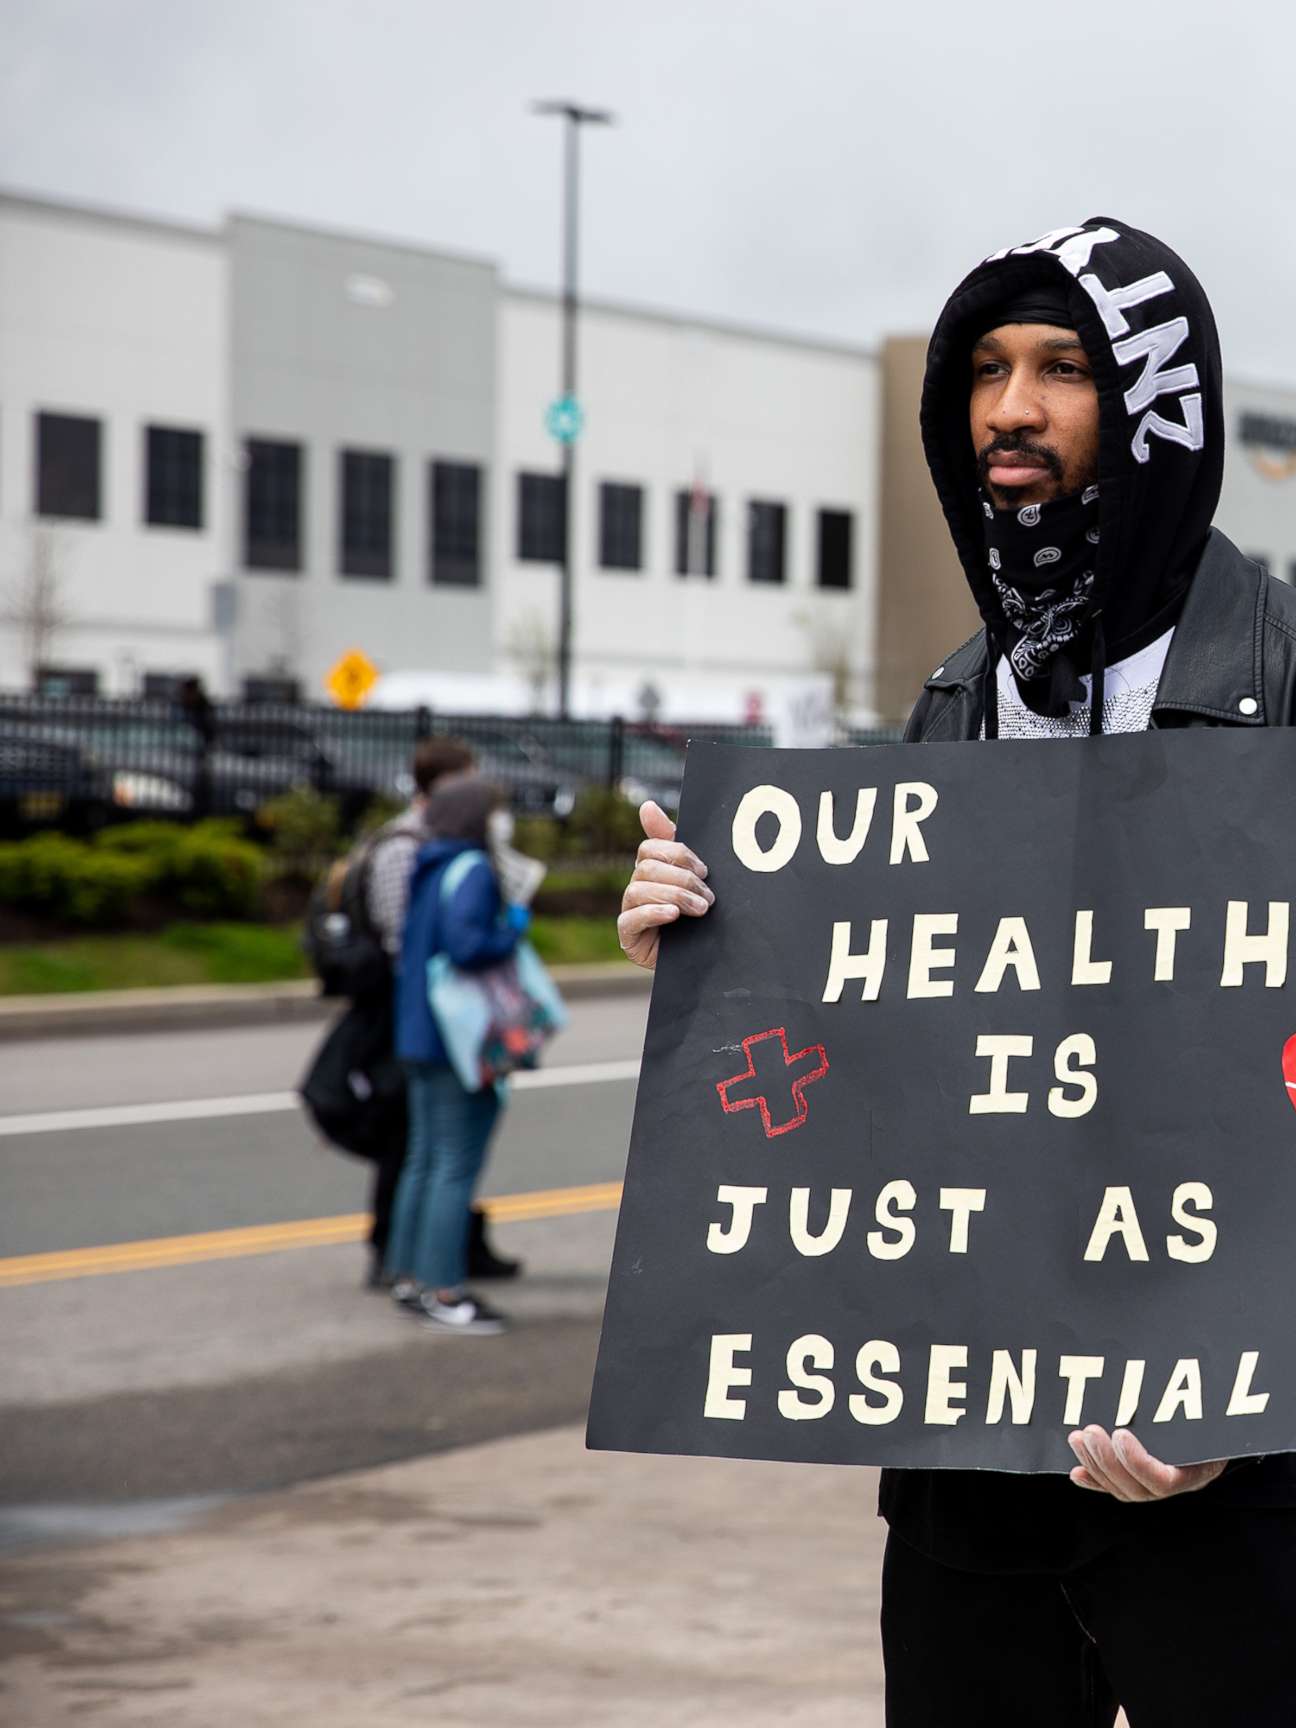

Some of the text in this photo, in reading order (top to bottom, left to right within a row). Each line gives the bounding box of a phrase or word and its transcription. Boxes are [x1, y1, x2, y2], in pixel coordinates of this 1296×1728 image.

[731, 781, 939, 873] OUR
[821, 900, 1290, 1003] HEALTH
[969, 1033, 1098, 1119] IS
[706, 1179, 1218, 1264] JUST AS
